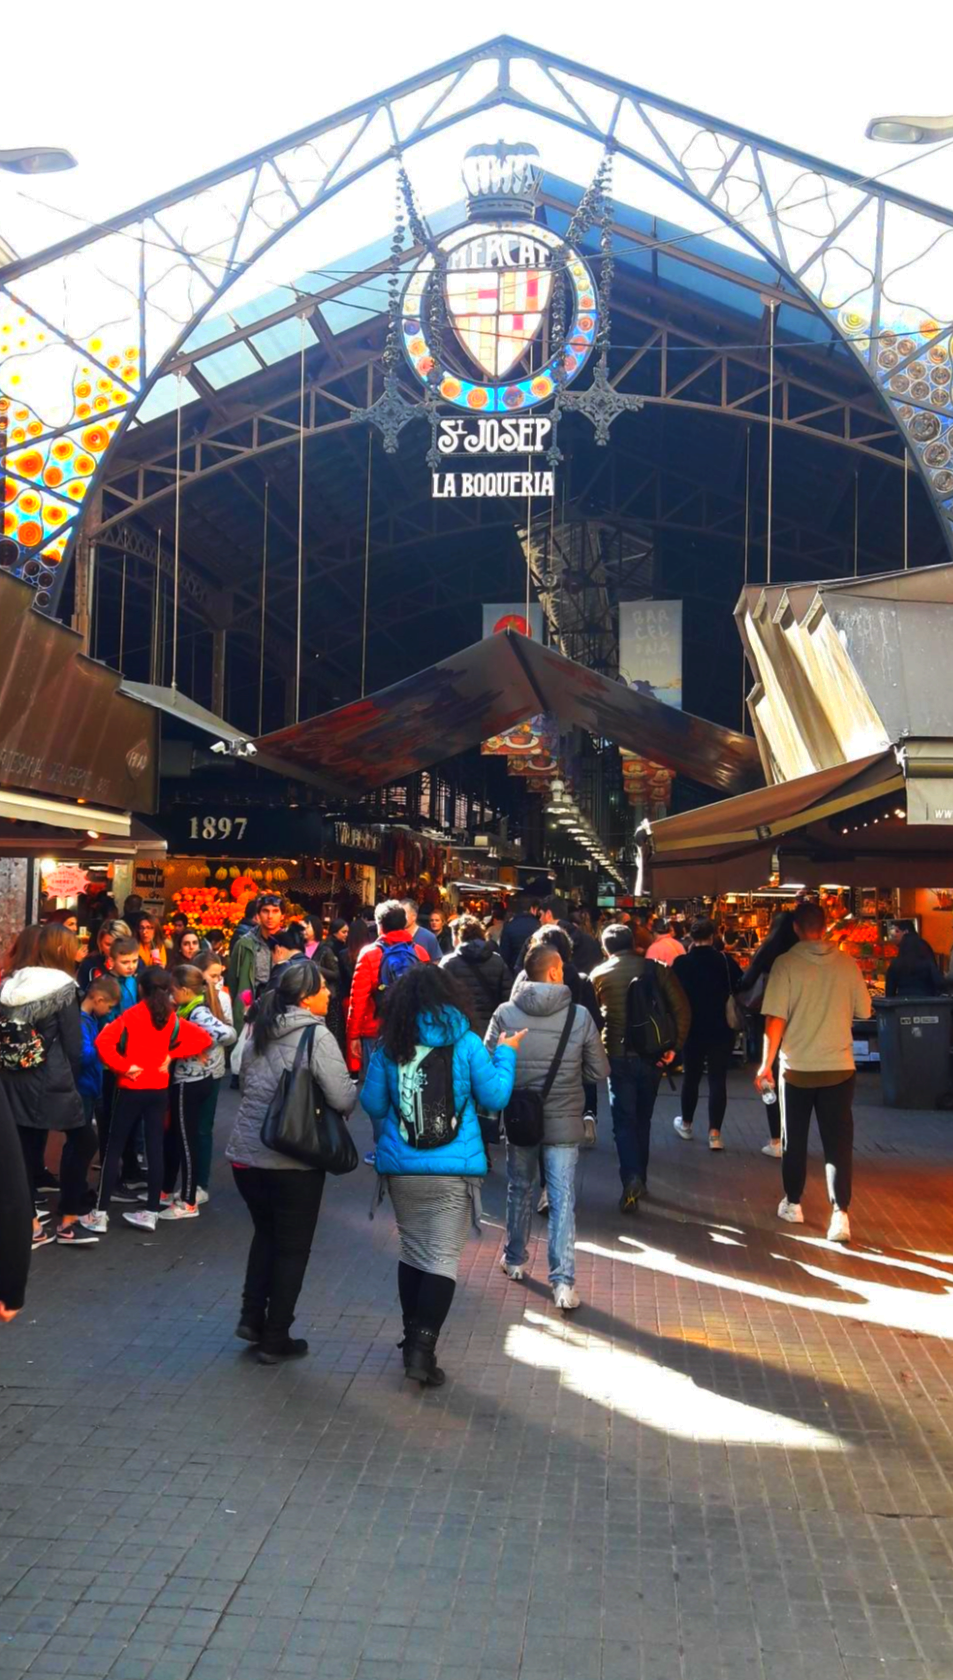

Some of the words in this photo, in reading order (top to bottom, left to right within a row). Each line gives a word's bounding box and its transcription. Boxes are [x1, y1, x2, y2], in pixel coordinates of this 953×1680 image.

[447, 235, 550, 269] MERCAT
[464, 418, 552, 453] JOSEP
[432, 473, 456, 498] LA
[461, 472, 555, 497] BOQUERIA
[188, 816, 248, 840] 1897
